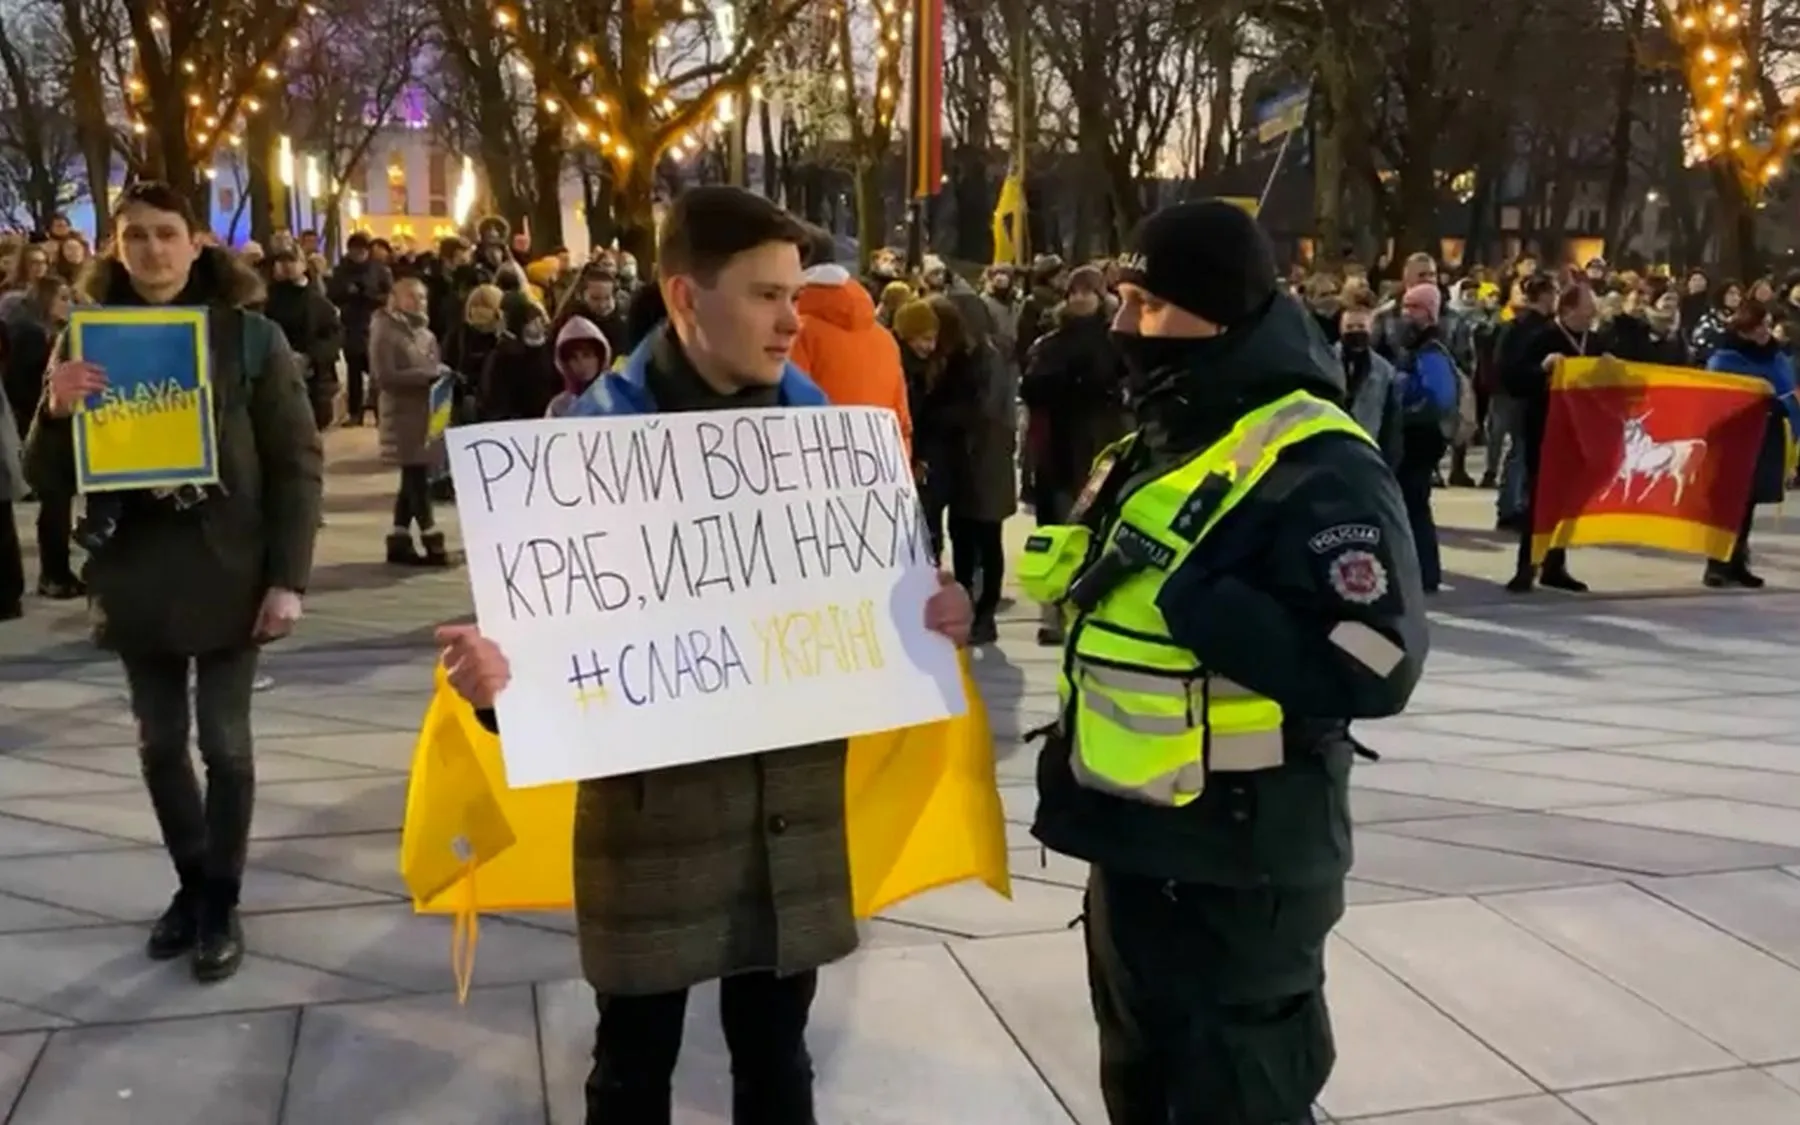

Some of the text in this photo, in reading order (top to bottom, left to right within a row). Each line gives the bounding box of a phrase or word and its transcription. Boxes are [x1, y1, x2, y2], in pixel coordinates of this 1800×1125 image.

[102, 376, 184, 405] SLAVA
[466, 412, 910, 512] РУСКИЙ ВОЕННЫЙ
[786, 488, 938, 579] НАХУЙ
[1314, 526, 1376, 549] POLICIJA
